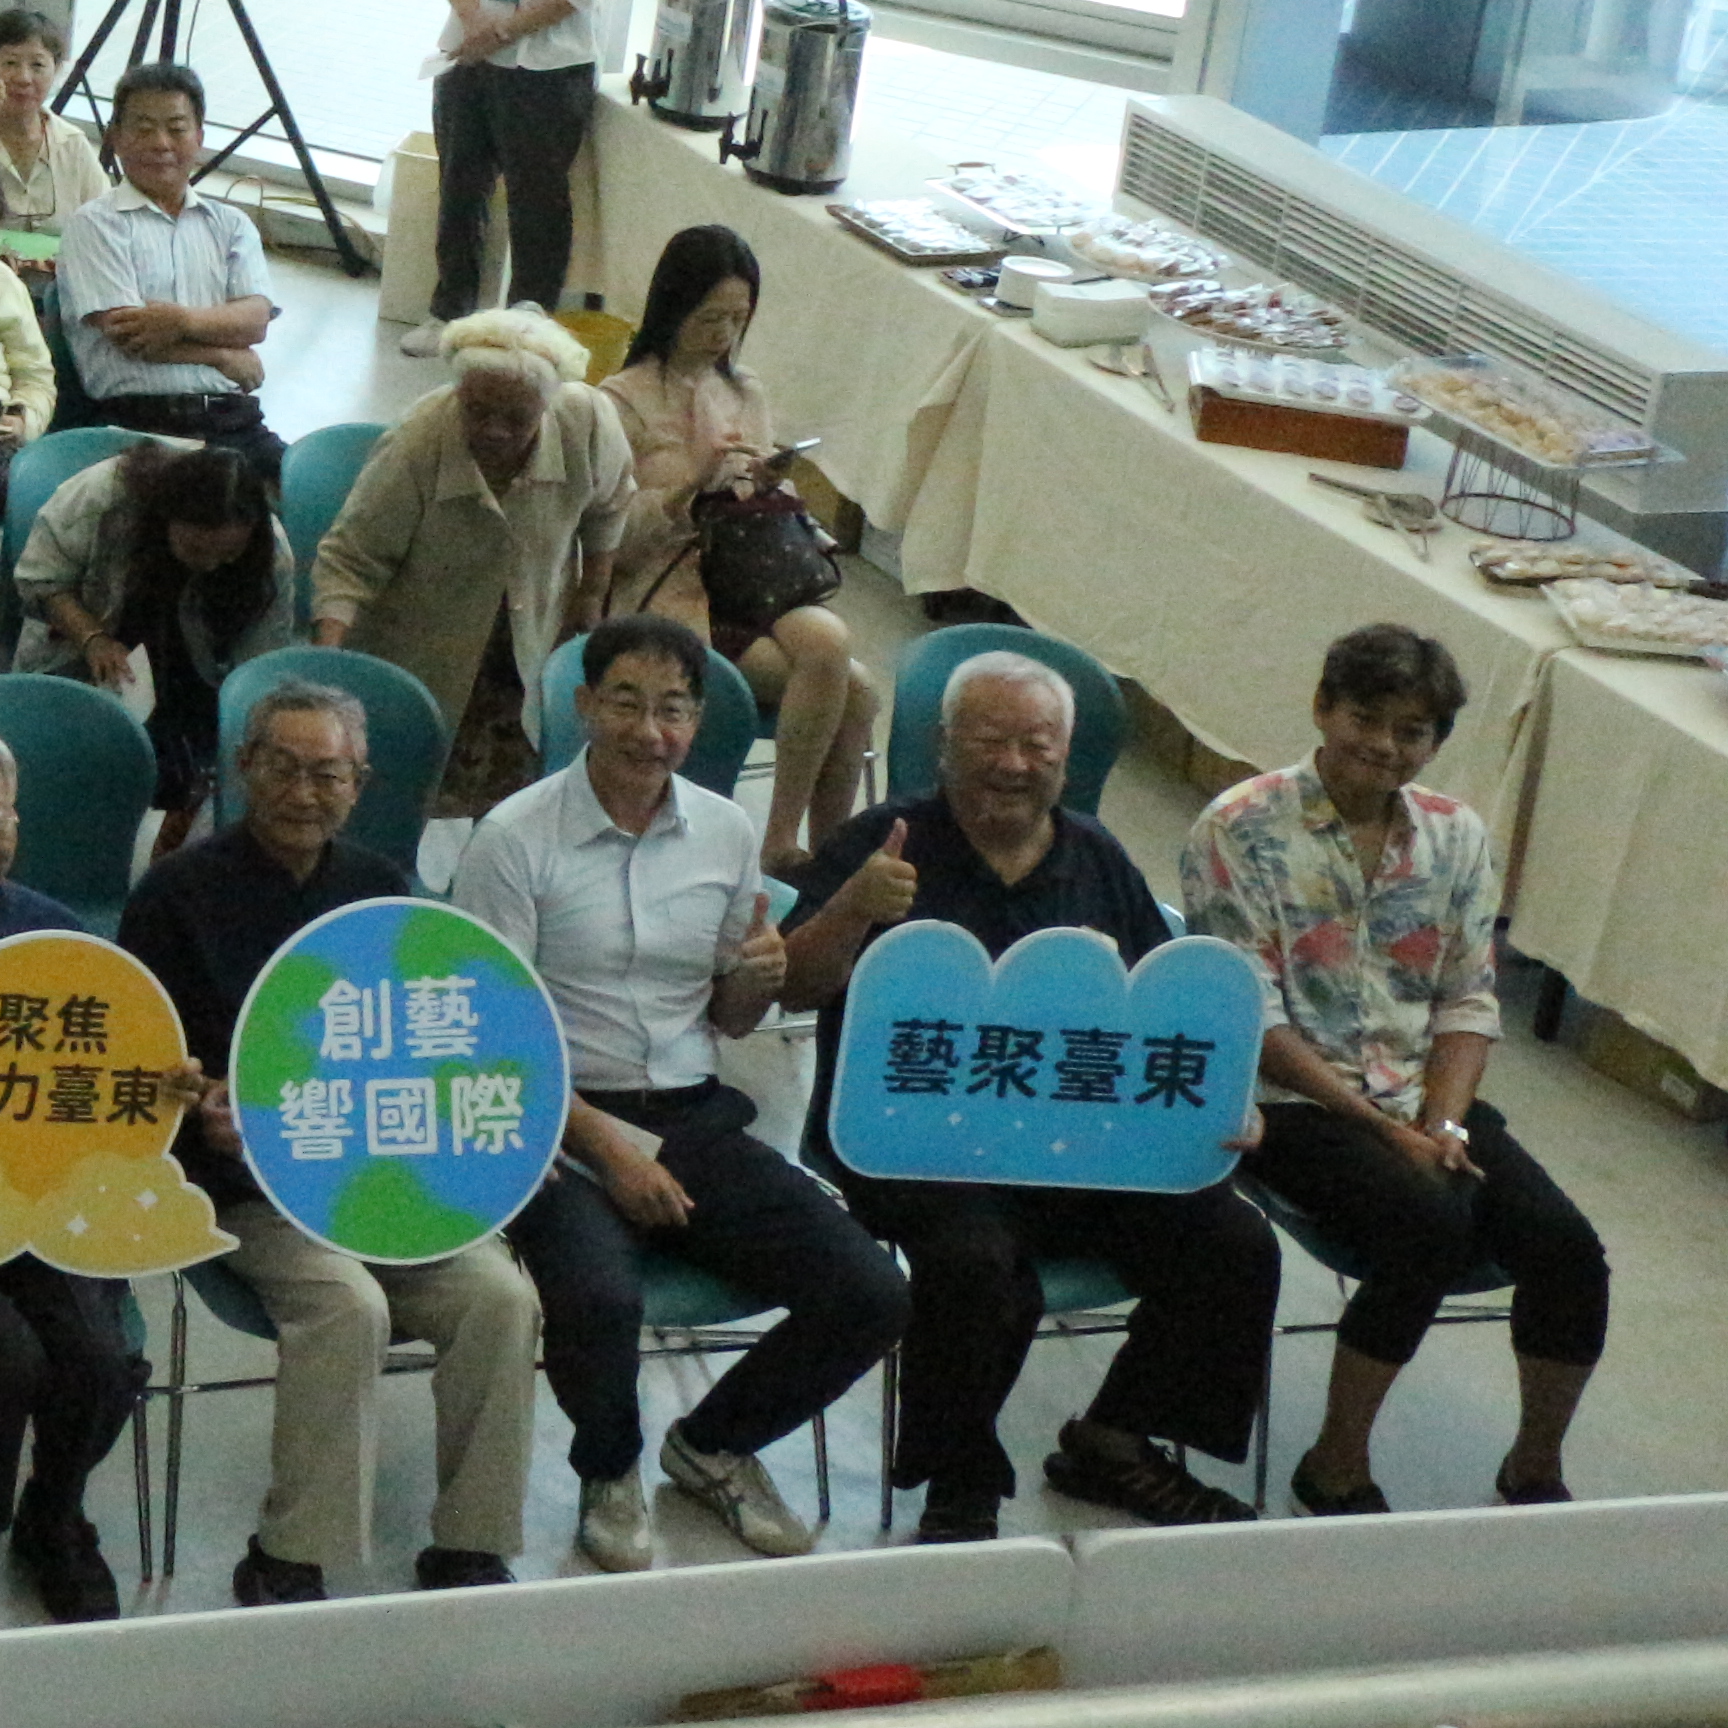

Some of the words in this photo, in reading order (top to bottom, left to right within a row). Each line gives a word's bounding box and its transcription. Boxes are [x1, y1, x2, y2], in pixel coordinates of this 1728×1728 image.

[318, 975, 479, 1060] 創藝
[883, 1019, 1215, 1108] 藝聚臺東
[279, 1073, 524, 1160] 響國際
